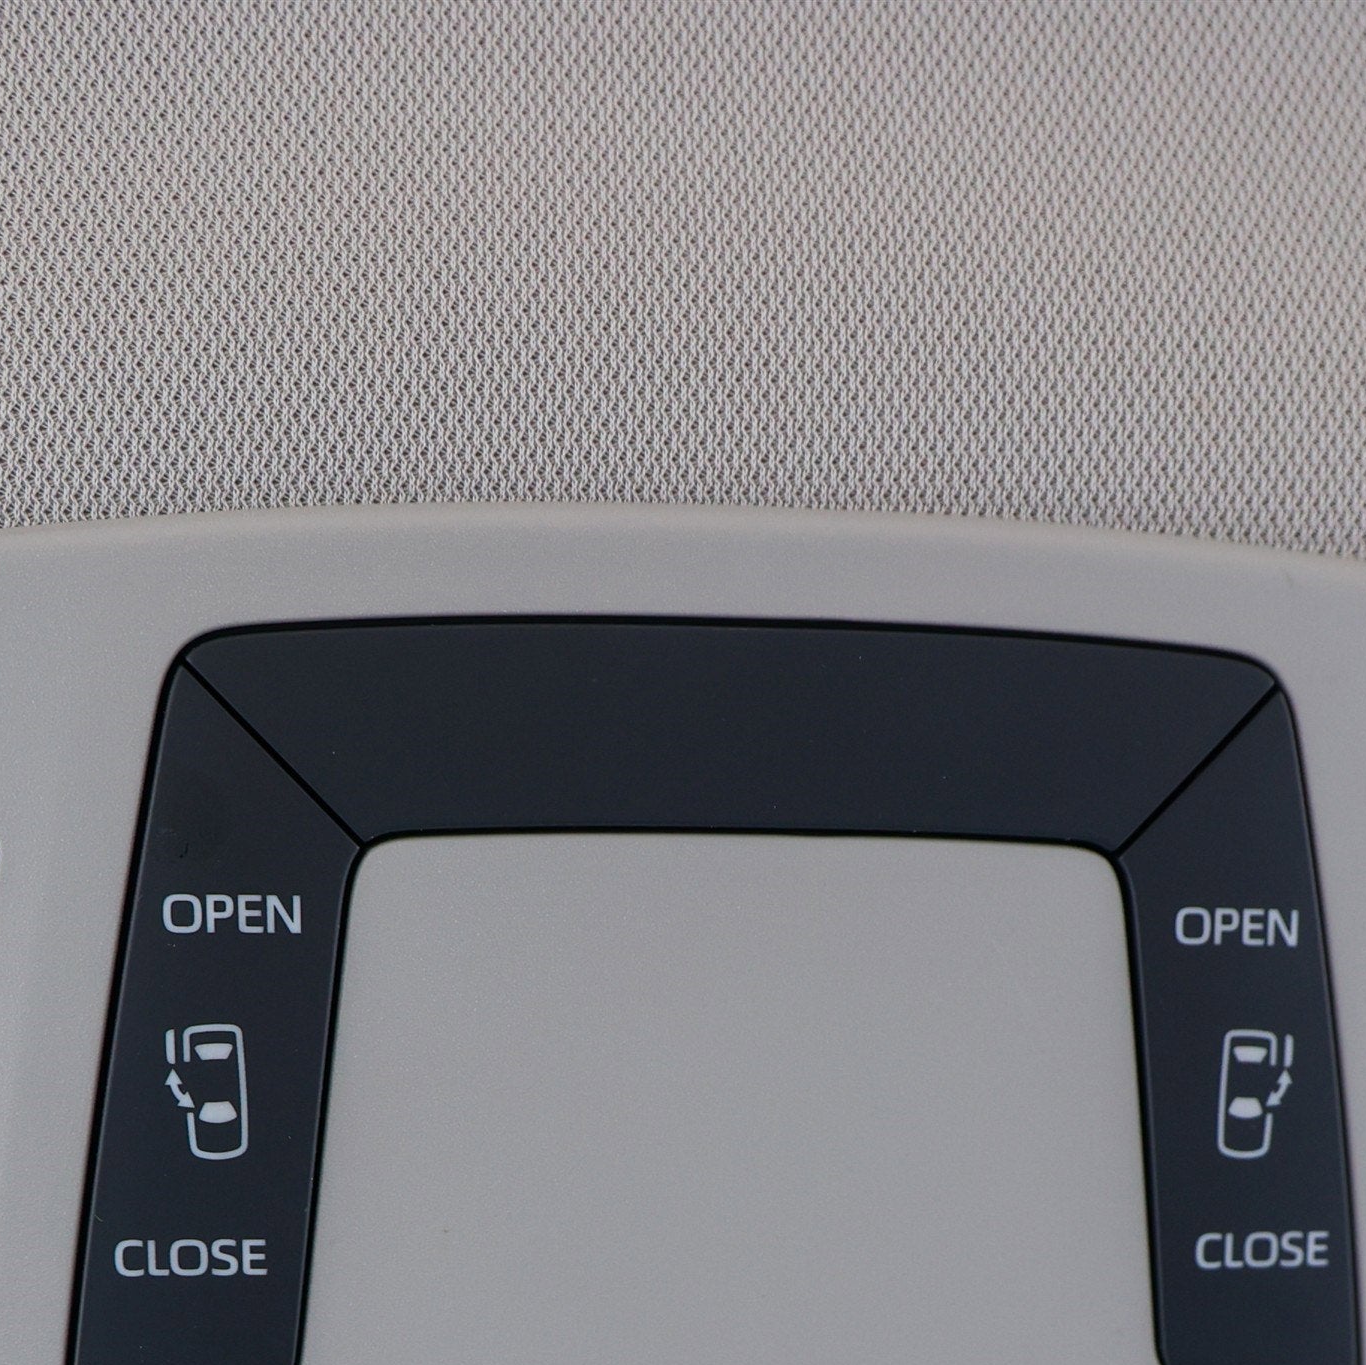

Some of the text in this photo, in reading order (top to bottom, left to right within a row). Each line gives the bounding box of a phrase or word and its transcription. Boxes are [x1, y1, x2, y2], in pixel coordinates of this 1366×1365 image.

[162, 893, 302, 934] OPEN
[1175, 906, 1299, 947] OPEN
[114, 1239, 268, 1277] CLOSE
[1195, 1231, 1330, 1269] CLOSE
